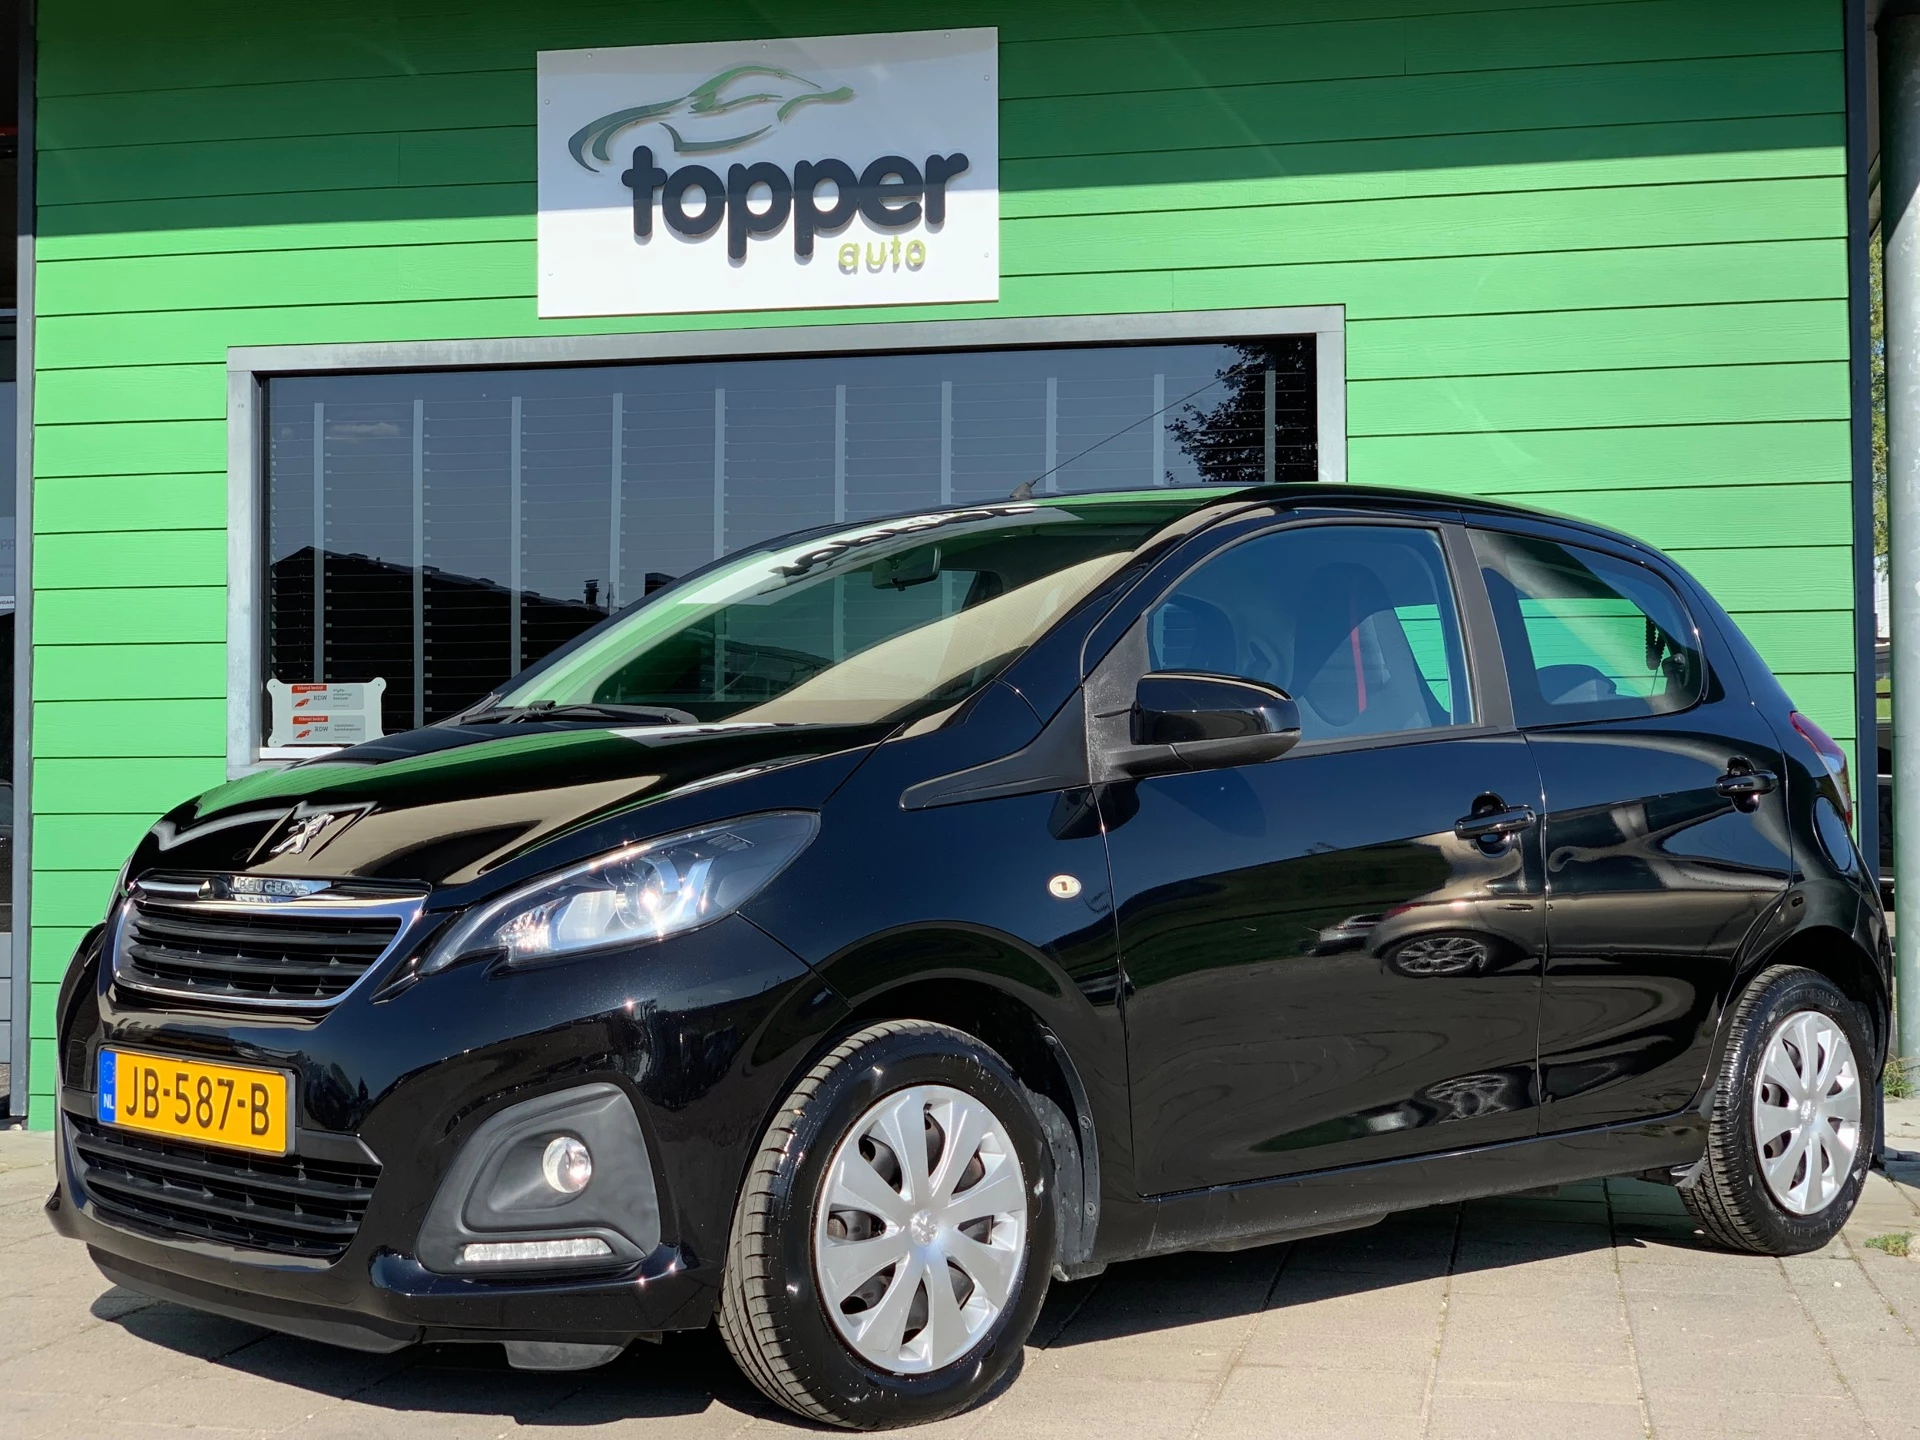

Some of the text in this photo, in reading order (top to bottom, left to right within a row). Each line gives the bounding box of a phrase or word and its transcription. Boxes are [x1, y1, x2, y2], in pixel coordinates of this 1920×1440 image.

[621, 144, 969, 260] topper
[838, 235, 927, 268] auto
[103, 1093, 114, 1110] NL
[125, 1066, 270, 1136] JB-587-B
